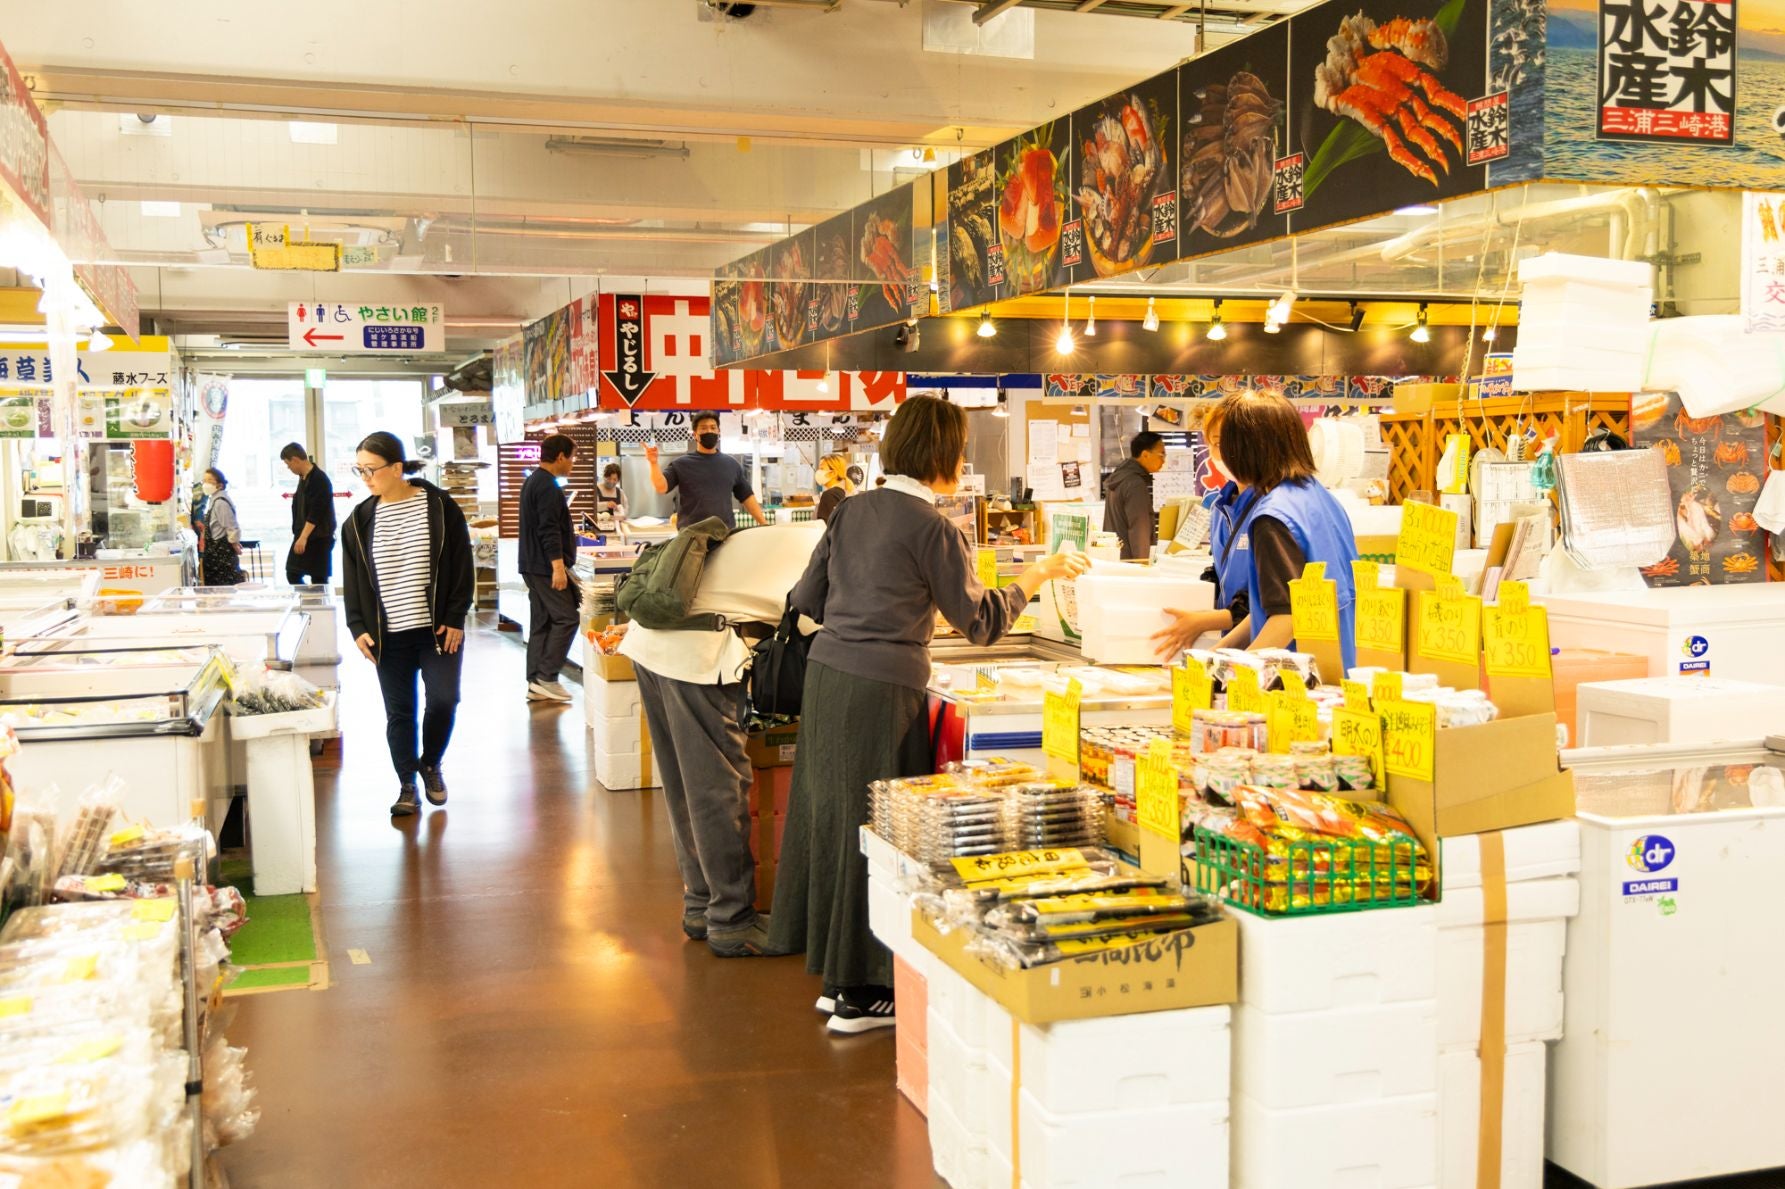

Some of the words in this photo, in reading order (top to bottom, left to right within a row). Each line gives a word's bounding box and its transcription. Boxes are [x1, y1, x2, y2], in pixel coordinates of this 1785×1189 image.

[1603, 0, 1670, 108] 水産
[1668, 2, 1732, 112] 鈴木
[1469, 111, 1488, 152] 水産
[1487, 107, 1507, 146] 鈴木
[1602, 109, 1728, 138] 三浦三崎港
[358, 306, 428, 323] やさい館
[619, 321, 640, 391] やじるし
[112, 371, 168, 386] 藤水フーズ
[1691, 640, 1706, 653] dr
[1683, 662, 1707, 670] DAIREI
[1646, 843, 1671, 864] dr
[1629, 880, 1672, 894] DAIREI
